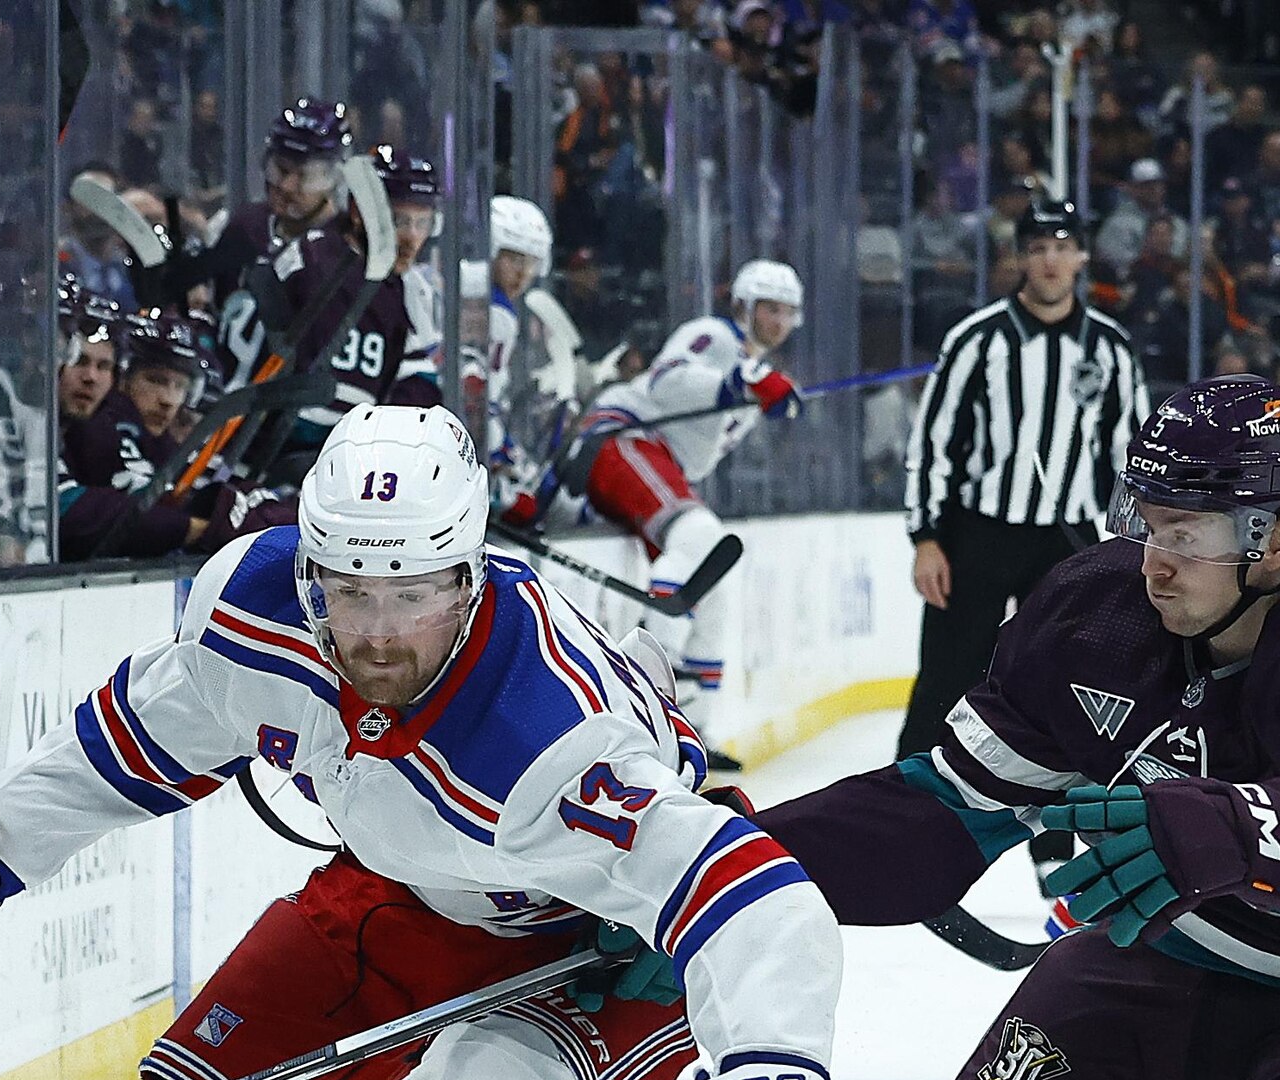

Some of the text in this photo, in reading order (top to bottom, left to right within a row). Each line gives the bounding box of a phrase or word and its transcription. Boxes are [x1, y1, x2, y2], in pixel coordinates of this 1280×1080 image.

[331, 329, 385, 378] 39
[1131, 456, 1168, 475] CCM
[361, 471, 398, 501] 13
[346, 536, 406, 548] BAUER
[558, 762, 658, 852] 13
